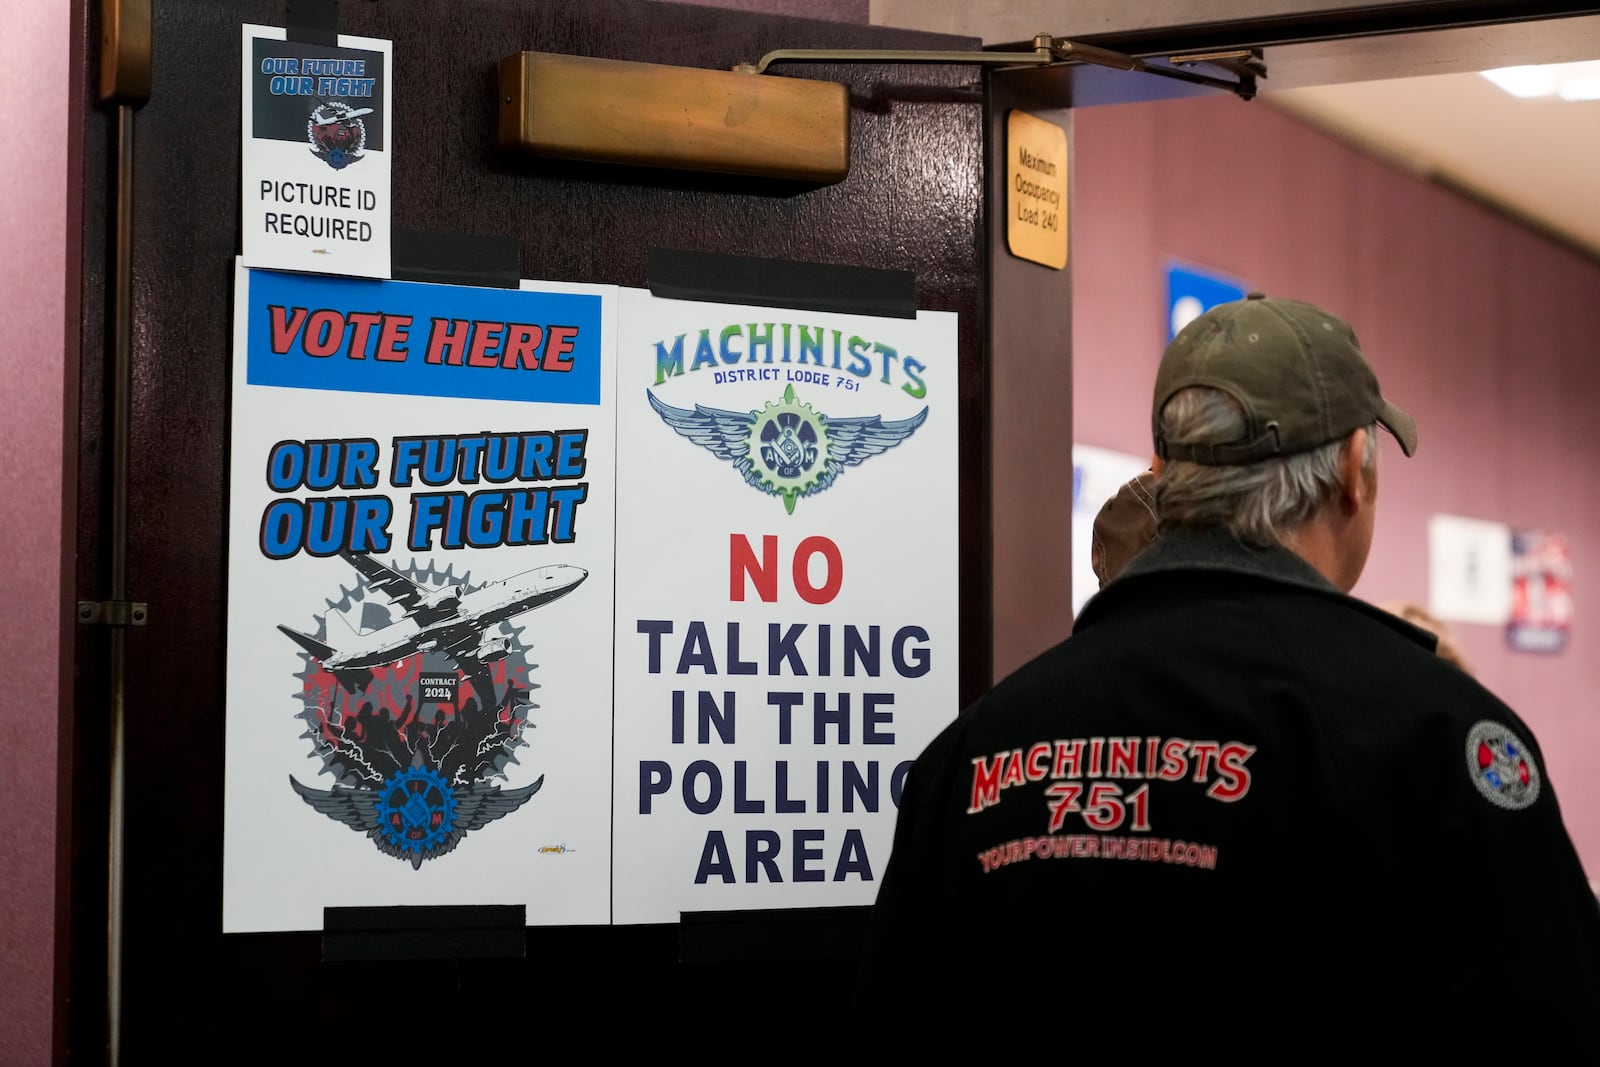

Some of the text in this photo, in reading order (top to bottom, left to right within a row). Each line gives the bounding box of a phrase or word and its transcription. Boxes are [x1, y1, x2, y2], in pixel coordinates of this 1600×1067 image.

[262, 58, 365, 76] OUR FUTURE
[270, 77, 375, 97] OUR FIGHT
[1019, 147, 1057, 177] Maximum
[261, 180, 376, 211] PICTURE ID
[1015, 173, 1061, 210] Occupancy
[265, 212, 372, 242] REQUIRED
[1017, 201, 1059, 232] Load 240
[267, 304, 579, 372] VOTE HERE
[652, 323, 928, 399] MACHINISTS
[713, 368, 860, 392] DISTRICT LODGE 751
[266, 428, 589, 493] OUR FUTURE
[259, 482, 589, 560] OUR FIGHT
[729, 533, 844, 605] NO
[637, 619, 931, 679] TALKING
[420, 677, 457, 687] CONTRACT
[424, 687, 452, 700] 2024
[671, 690, 895, 745] IN THE
[966, 736, 1256, 815] MACHINISTS
[1045, 781, 1151, 834] 751
[693, 829, 874, 884] AREA
